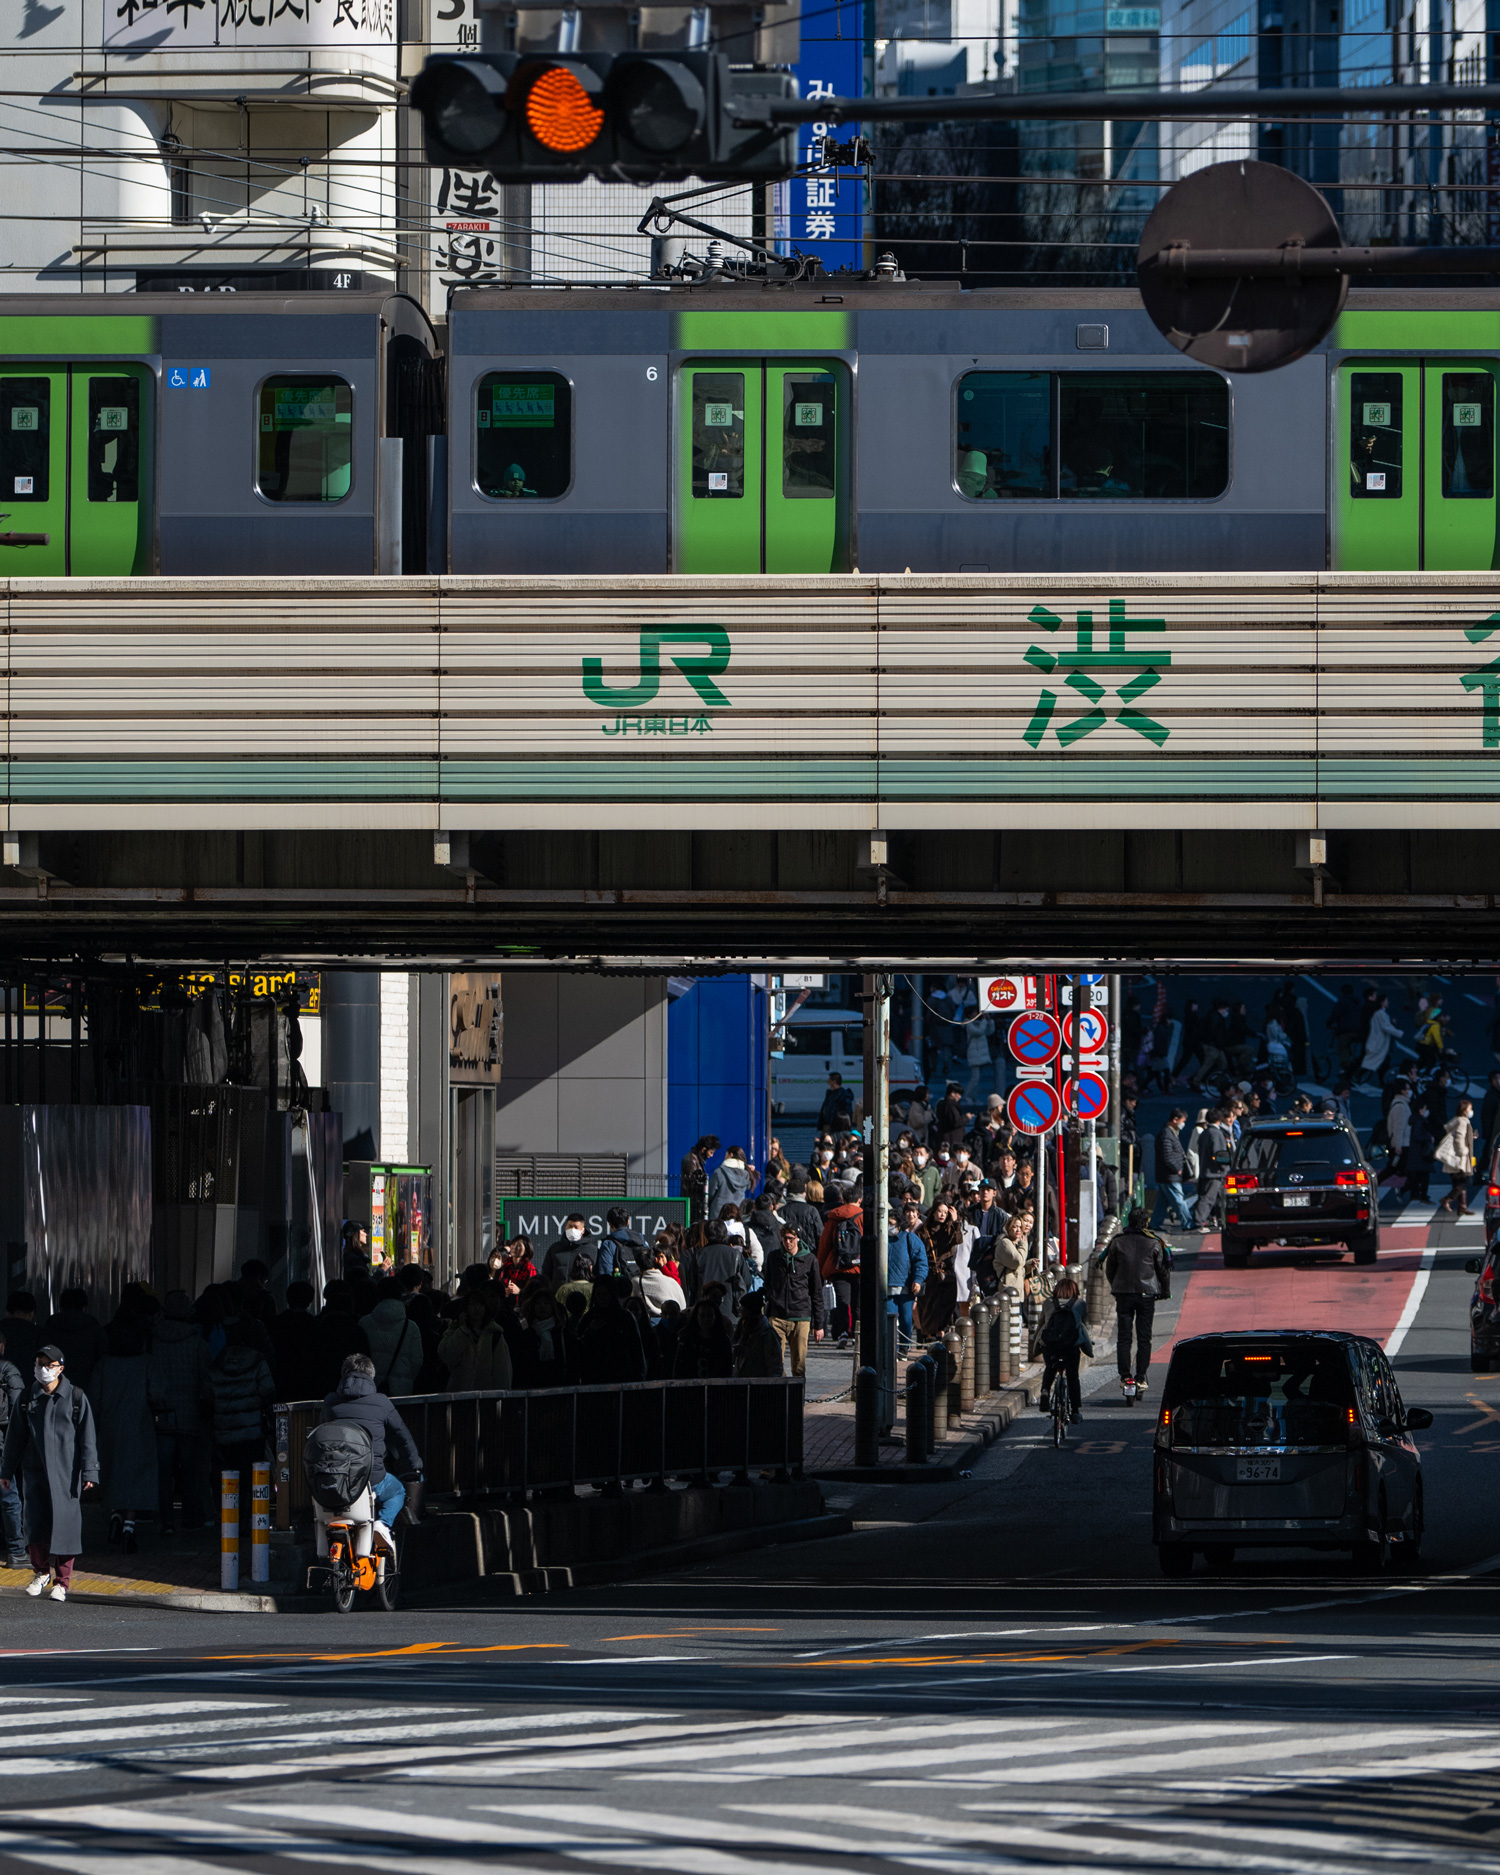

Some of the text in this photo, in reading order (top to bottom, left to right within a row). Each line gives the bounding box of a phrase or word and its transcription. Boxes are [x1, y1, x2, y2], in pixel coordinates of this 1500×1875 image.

[333, 273, 352, 288] 4F
[646, 366, 658, 381] 6
[498, 387, 539, 399] 優先席
[582, 623, 732, 708] JR
[601, 714, 714, 737] JR東日本
[991, 991, 1015, 1001] ガスト
[1068, 991, 1102, 1001] 820
[1247, 1467, 1278, 1478] 96-74
